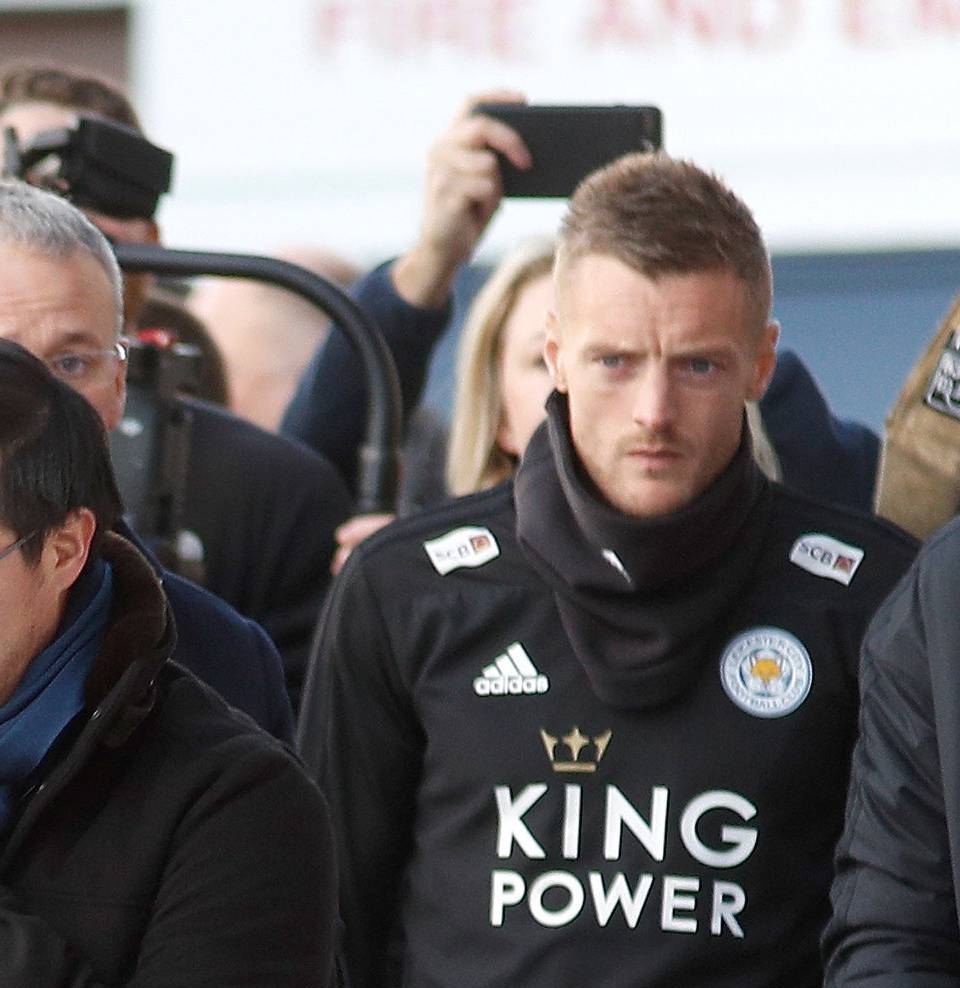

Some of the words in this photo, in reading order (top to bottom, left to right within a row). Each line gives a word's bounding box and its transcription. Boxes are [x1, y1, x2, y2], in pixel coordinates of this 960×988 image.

[473, 674, 549, 696] adidas
[494, 783, 758, 868] KING
[490, 870, 746, 938] POWER
